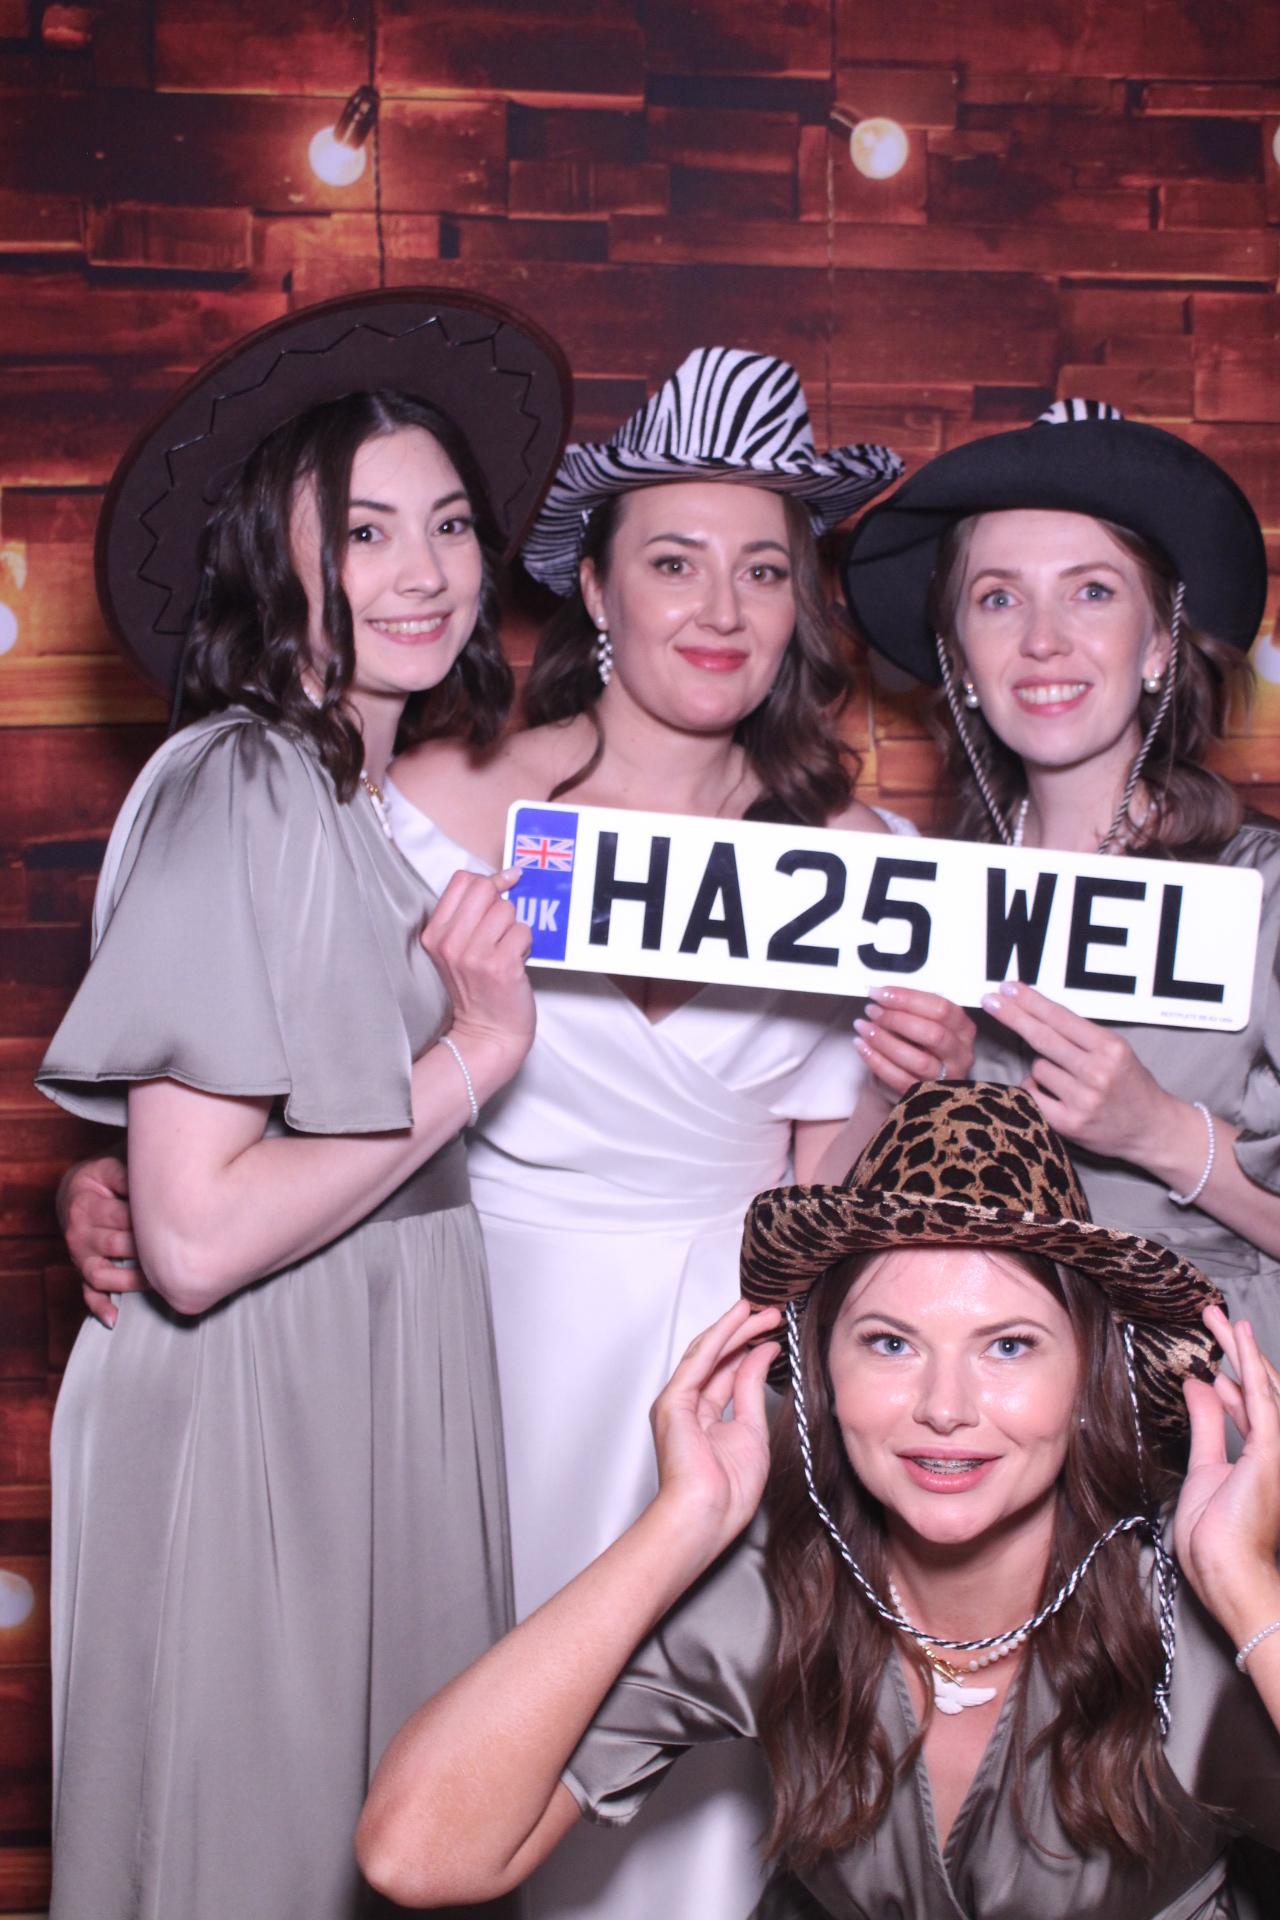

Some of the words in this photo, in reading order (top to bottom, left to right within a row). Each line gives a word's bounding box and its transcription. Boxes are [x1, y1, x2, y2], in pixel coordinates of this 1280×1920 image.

[516, 896, 560, 932] UK
[589, 831, 938, 974] HA25
[986, 867, 1225, 1003] WEL
